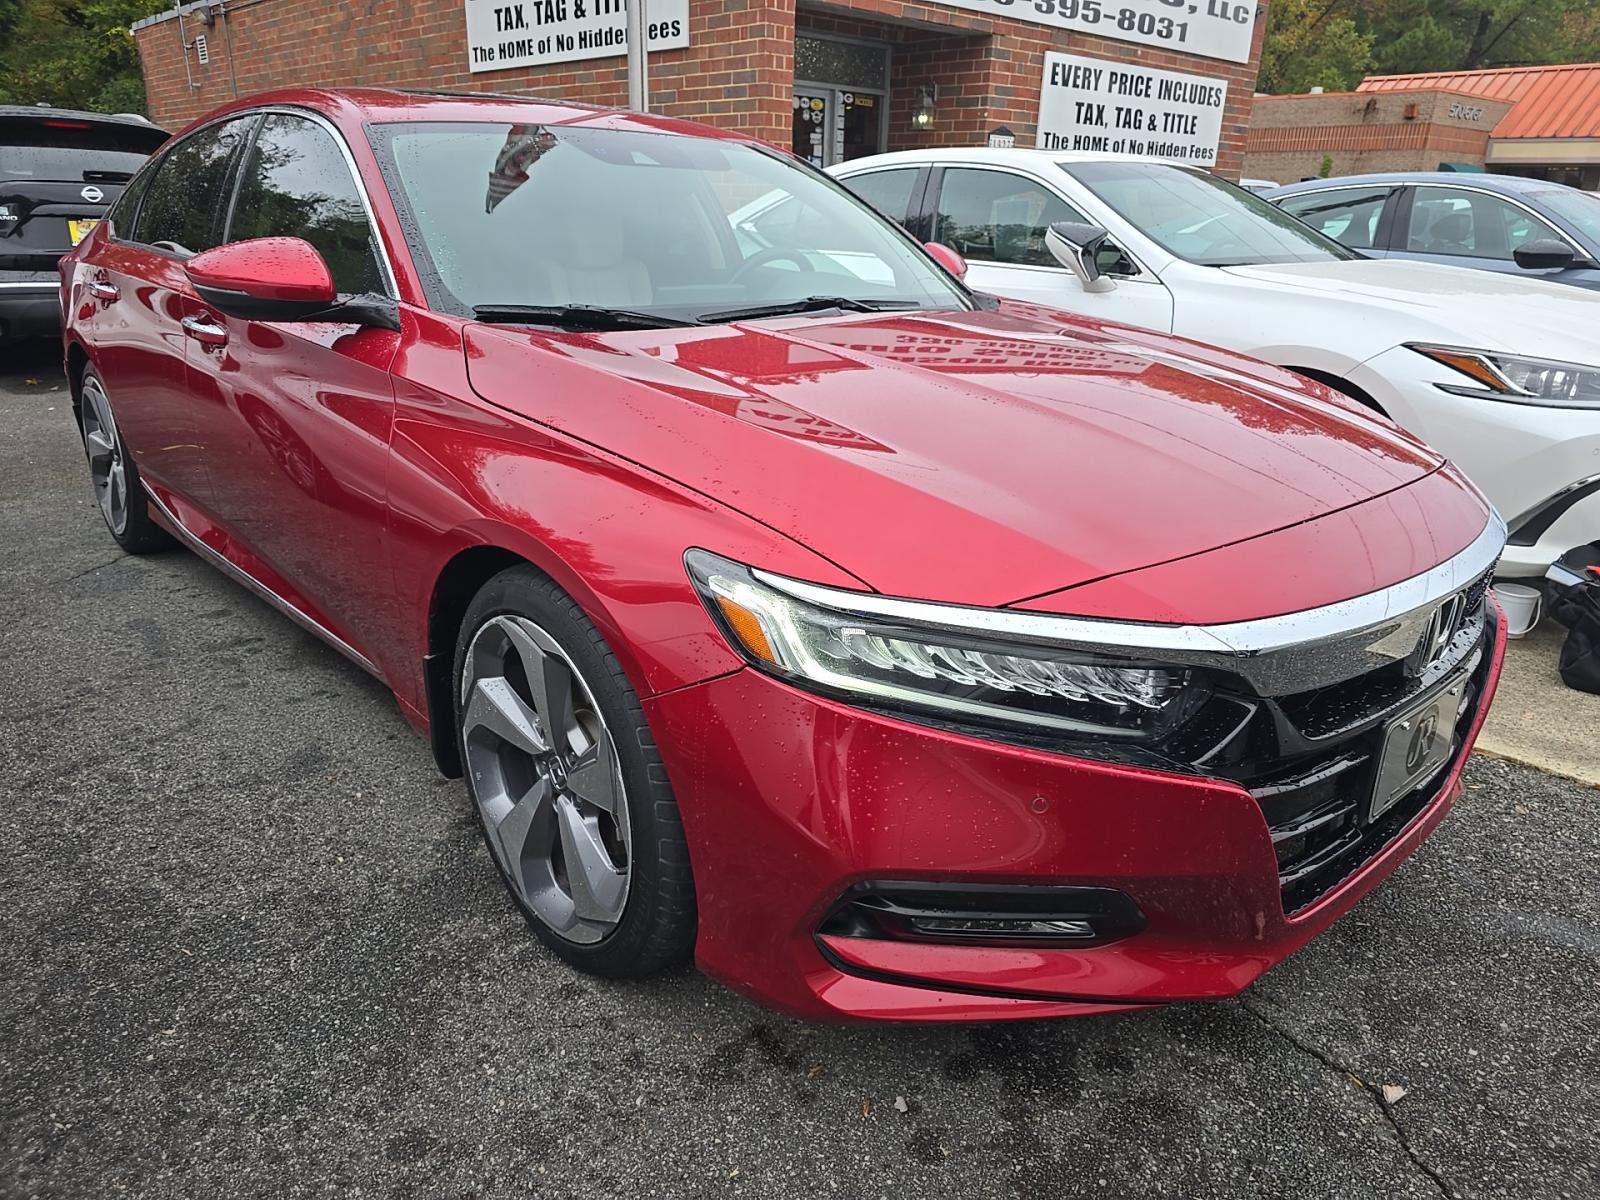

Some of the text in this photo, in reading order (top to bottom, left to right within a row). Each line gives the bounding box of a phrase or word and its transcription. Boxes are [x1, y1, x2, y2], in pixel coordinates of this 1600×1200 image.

[494, 4, 529, 31] TAX,
[534, 0, 567, 25] TAG
[574, 0, 587, 19] &
[472, 46, 495, 63] The
[499, 39, 534, 60] HOME
[538, 36, 551, 54] of
[556, 34, 574, 52] No
[578, 26, 628, 49] Hidde
[1050, 62, 1222, 108] EVERY PRICE INCLUDES
[1075, 101, 1198, 135] TAX, TAG & TITLE
[1043, 132, 1214, 160] The HOME of No Hidden Fees
